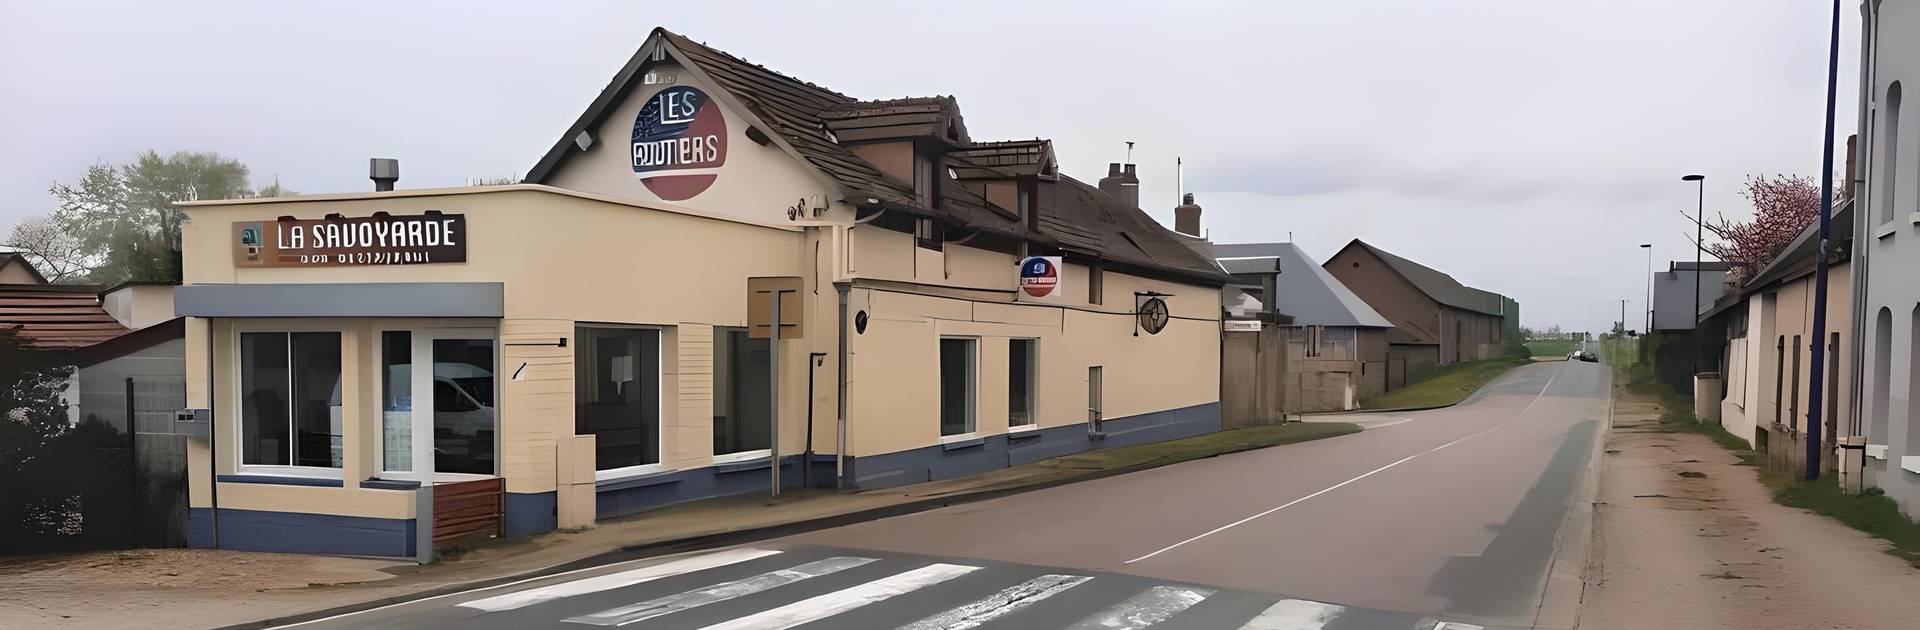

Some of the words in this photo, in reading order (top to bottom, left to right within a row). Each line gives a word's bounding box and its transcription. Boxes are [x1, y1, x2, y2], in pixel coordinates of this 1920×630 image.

[660, 91, 696, 124] LES
[277, 222, 304, 249] LA
[313, 219, 455, 248] SAVOYARDE
